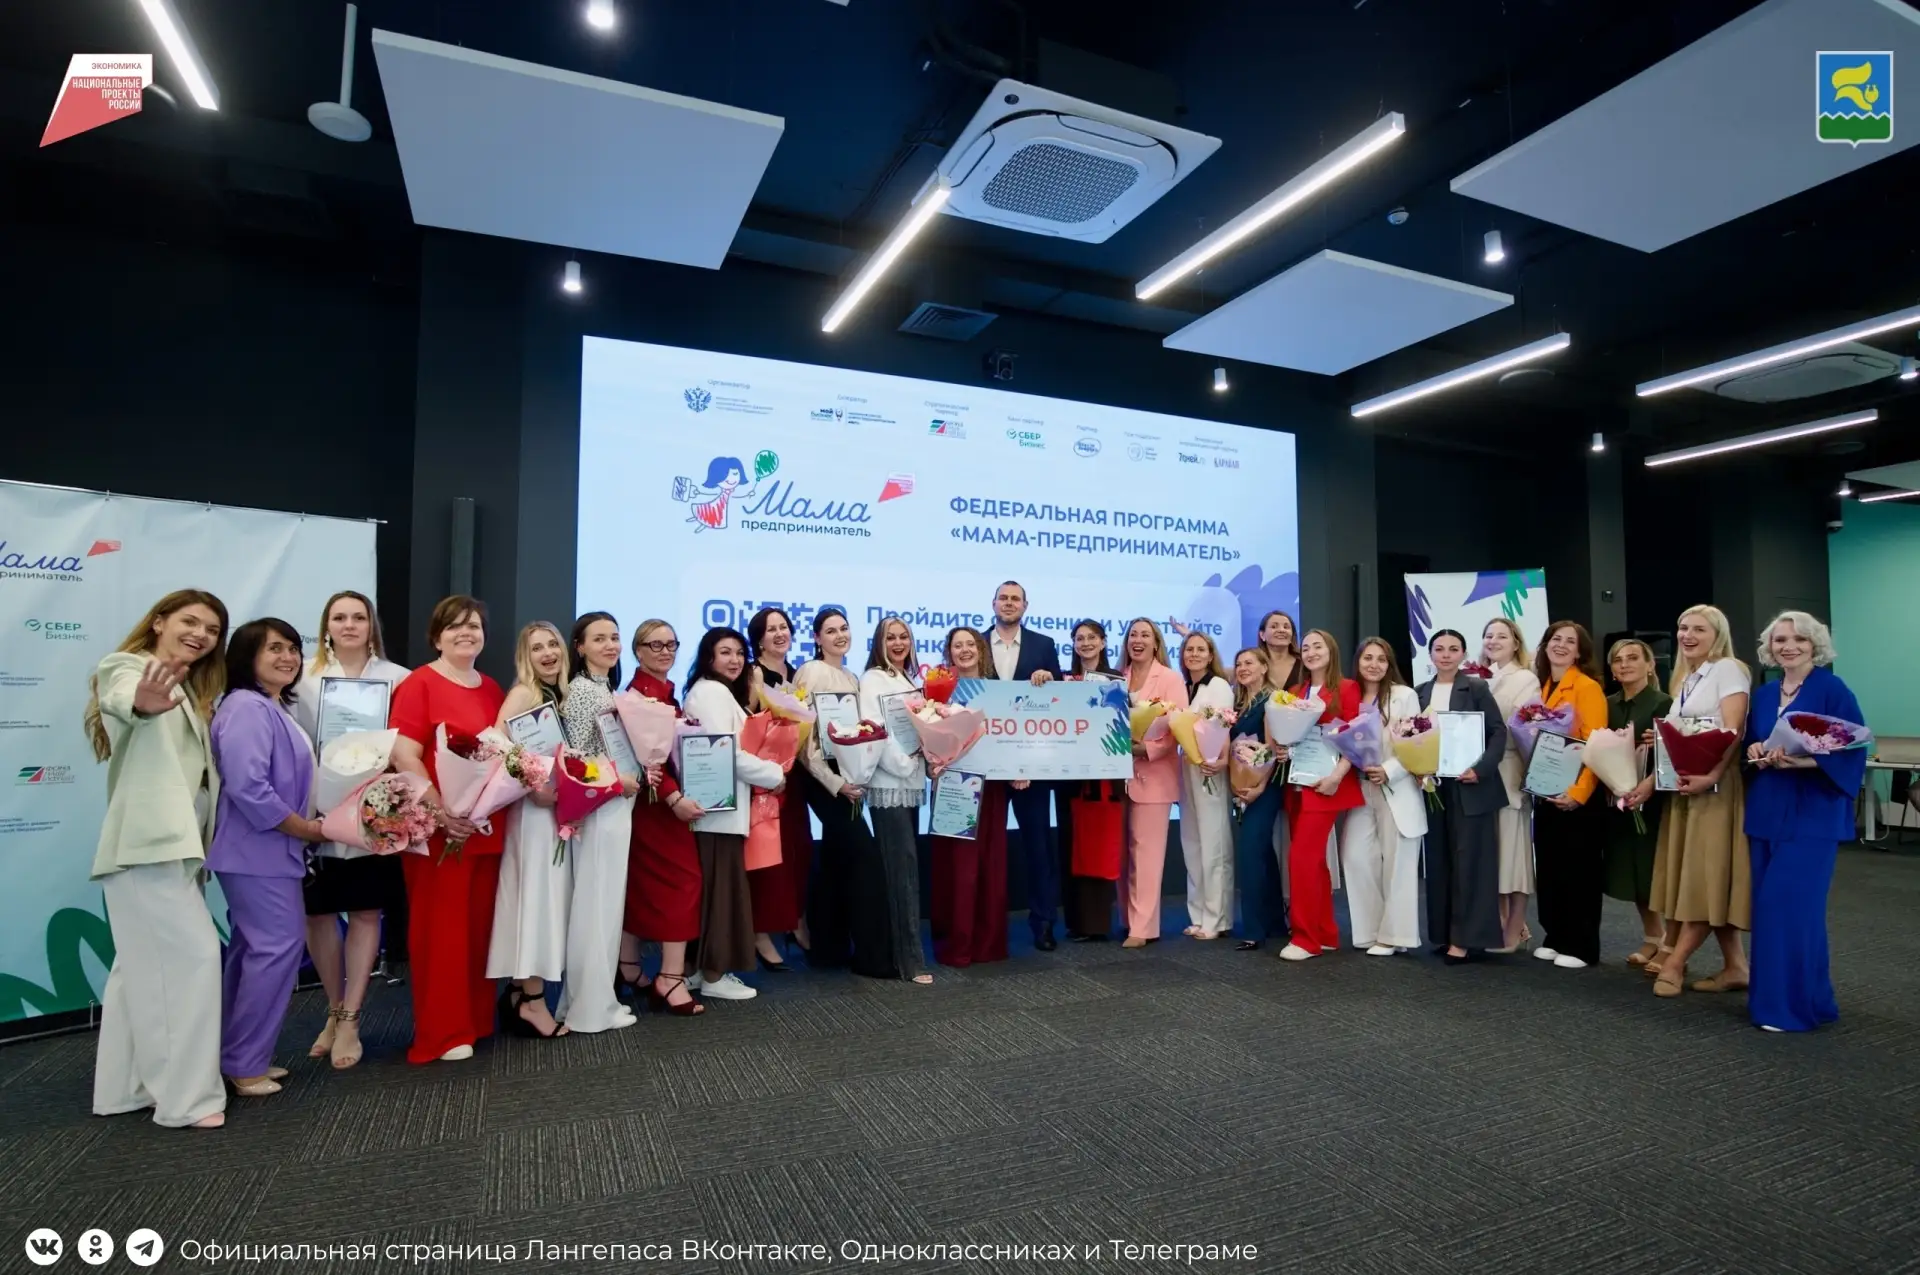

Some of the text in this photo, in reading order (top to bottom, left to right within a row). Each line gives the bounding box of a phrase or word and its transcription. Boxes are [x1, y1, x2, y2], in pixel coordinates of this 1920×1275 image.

[1019, 431, 1041, 440] СБЕР
[742, 480, 871, 523] Мама
[950, 496, 1229, 536] ФЕДЕРАЛЬНАЯ ПРОГРАММА
[741, 520, 871, 537] предприниматель
[950, 525, 1241, 562] «МАМА-ПРЕДПРИНИМАТЕЛЬ»
[0, 540, 84, 572] ама
[45, 622, 82, 631] СБЕР
[45, 631, 89, 641] Бизнес
[983, 718, 1018, 736] 150
[1024, 718, 1068, 736] 000
